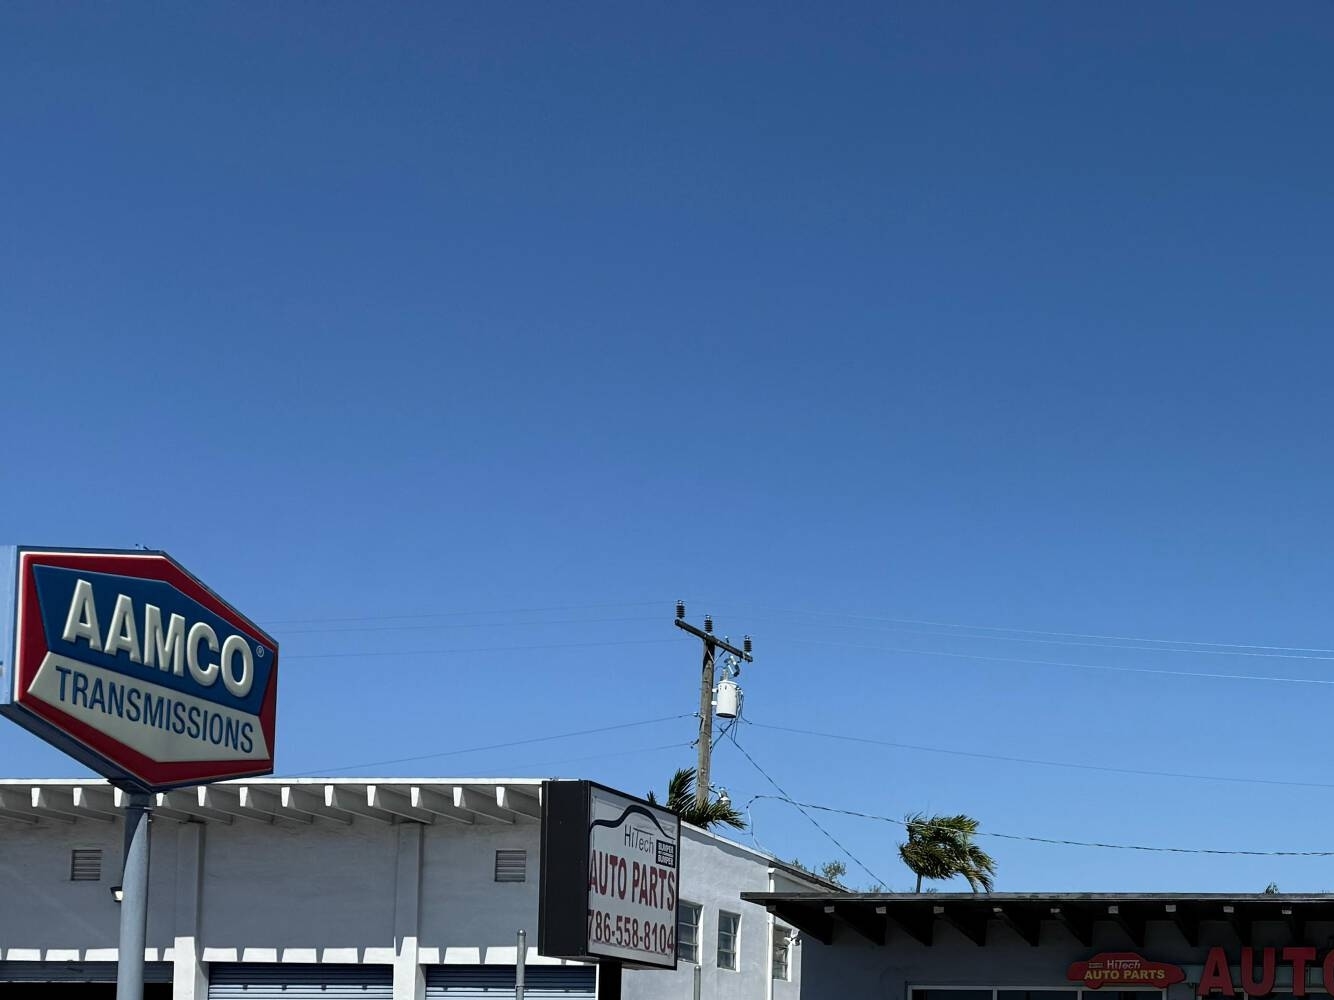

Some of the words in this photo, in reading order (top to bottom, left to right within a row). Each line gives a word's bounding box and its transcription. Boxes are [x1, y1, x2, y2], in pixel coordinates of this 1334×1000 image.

[62, 578, 254, 698] AAMCO
[55, 665, 254, 753] TRANSMISSIONS
[624, 824, 655, 855] HiTech
[588, 850, 627, 900] AUTO
[632, 861, 675, 912] PARTS
[587, 909, 675, 953] 786-558-8104
[1084, 969, 1120, 980] AUTO
[1123, 969, 1166, 980] PARTS
[1107, 959, 1141, 970] HiTech
